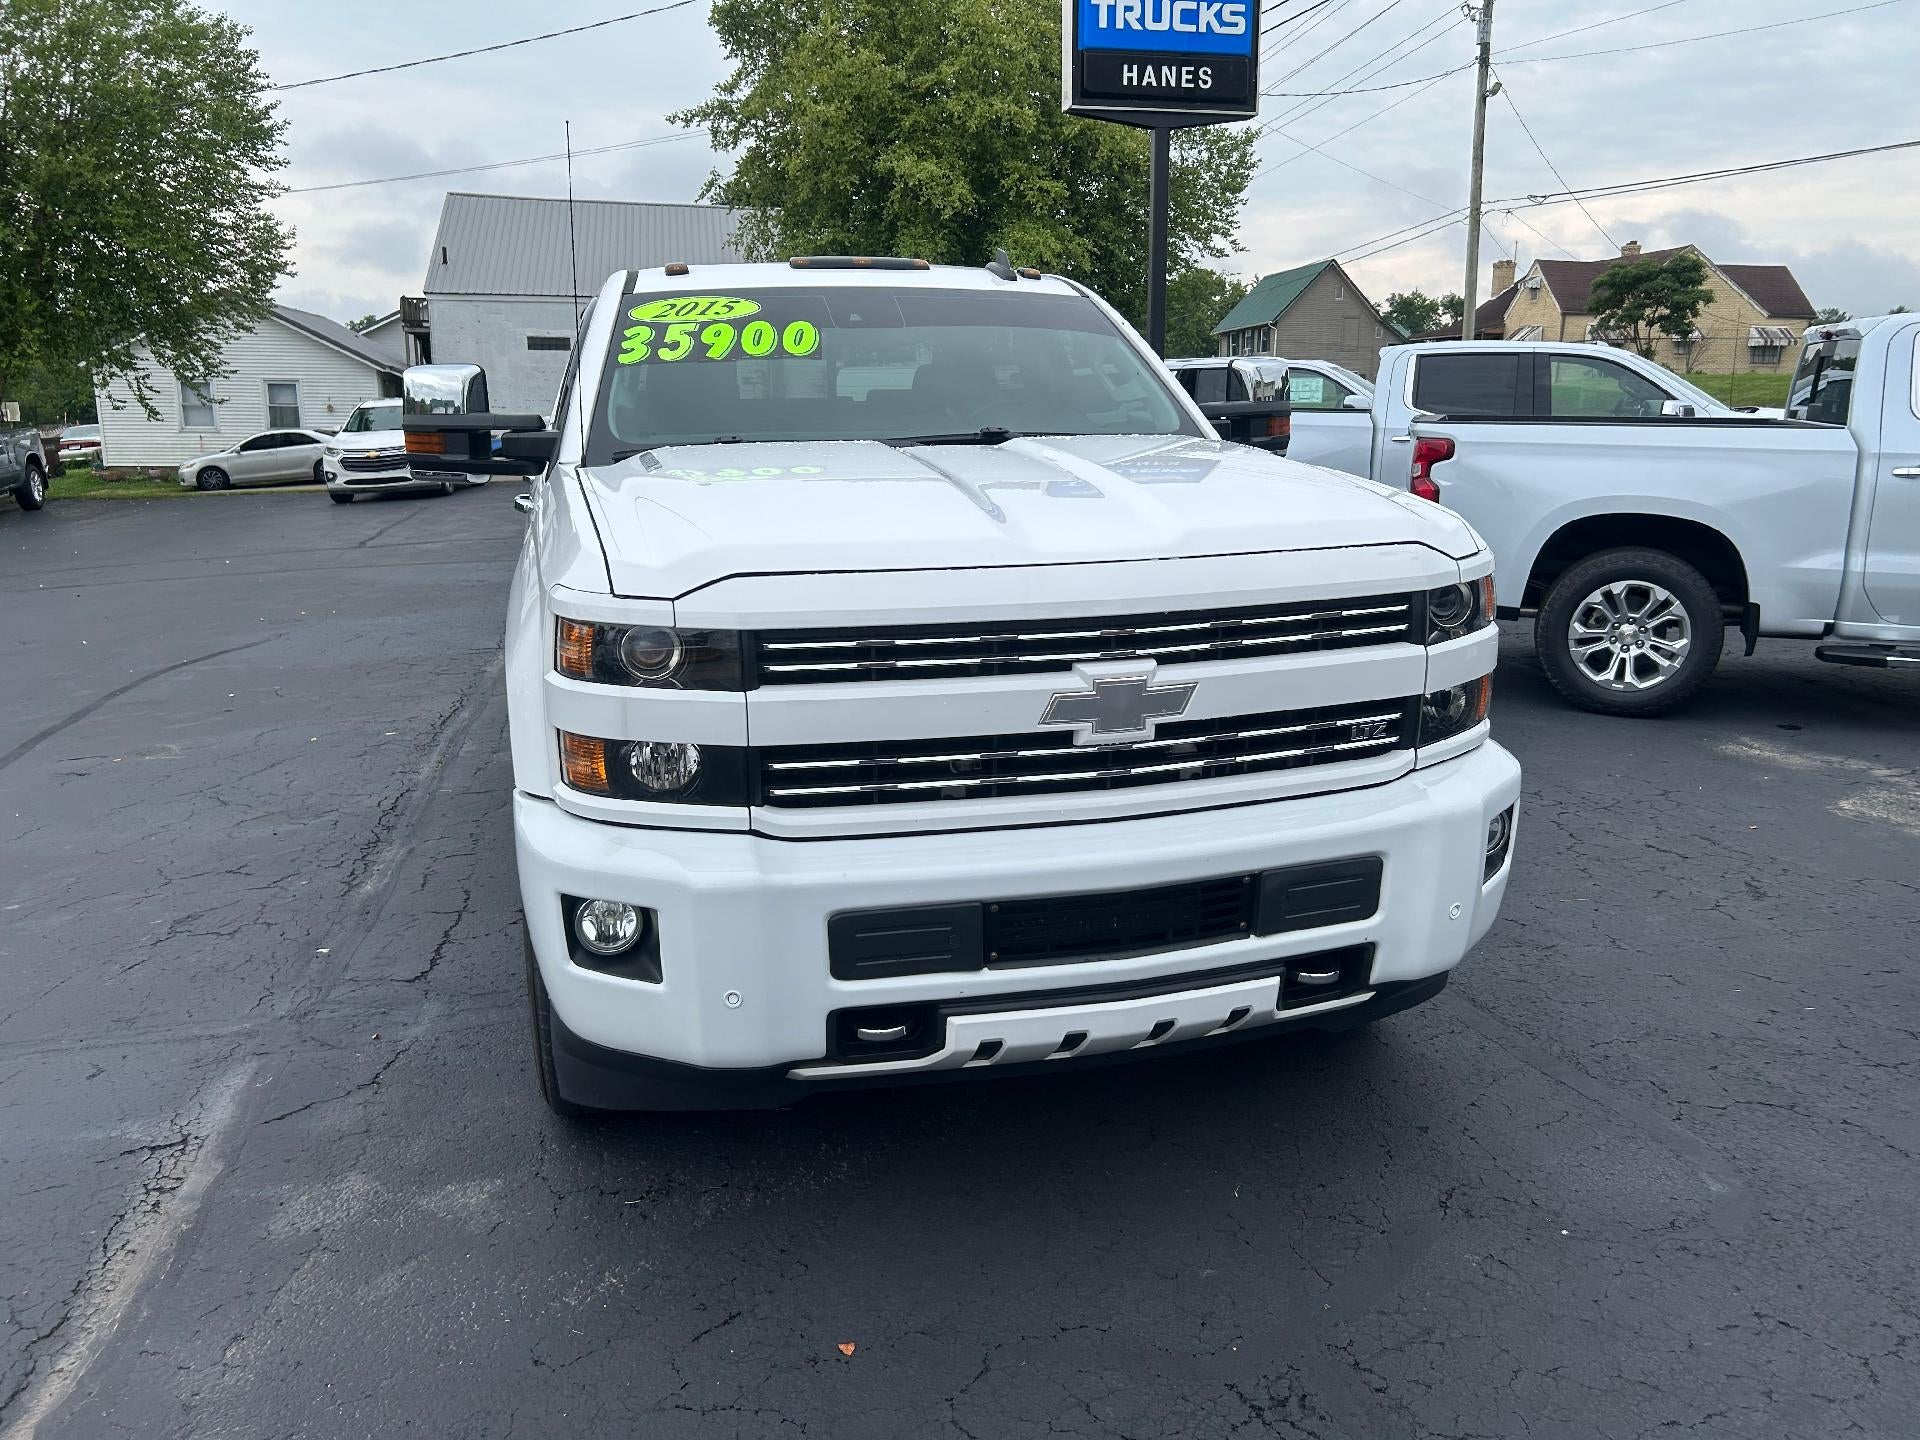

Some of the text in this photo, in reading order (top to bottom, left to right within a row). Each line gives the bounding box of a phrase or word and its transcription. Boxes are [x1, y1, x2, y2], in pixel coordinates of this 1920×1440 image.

[1090, 0, 1246, 35] TRUCKS
[1122, 63, 1213, 89] HANES
[653, 300, 740, 319] 2015
[617, 320, 820, 365] 35900
[1350, 721, 1388, 741] LTZ
